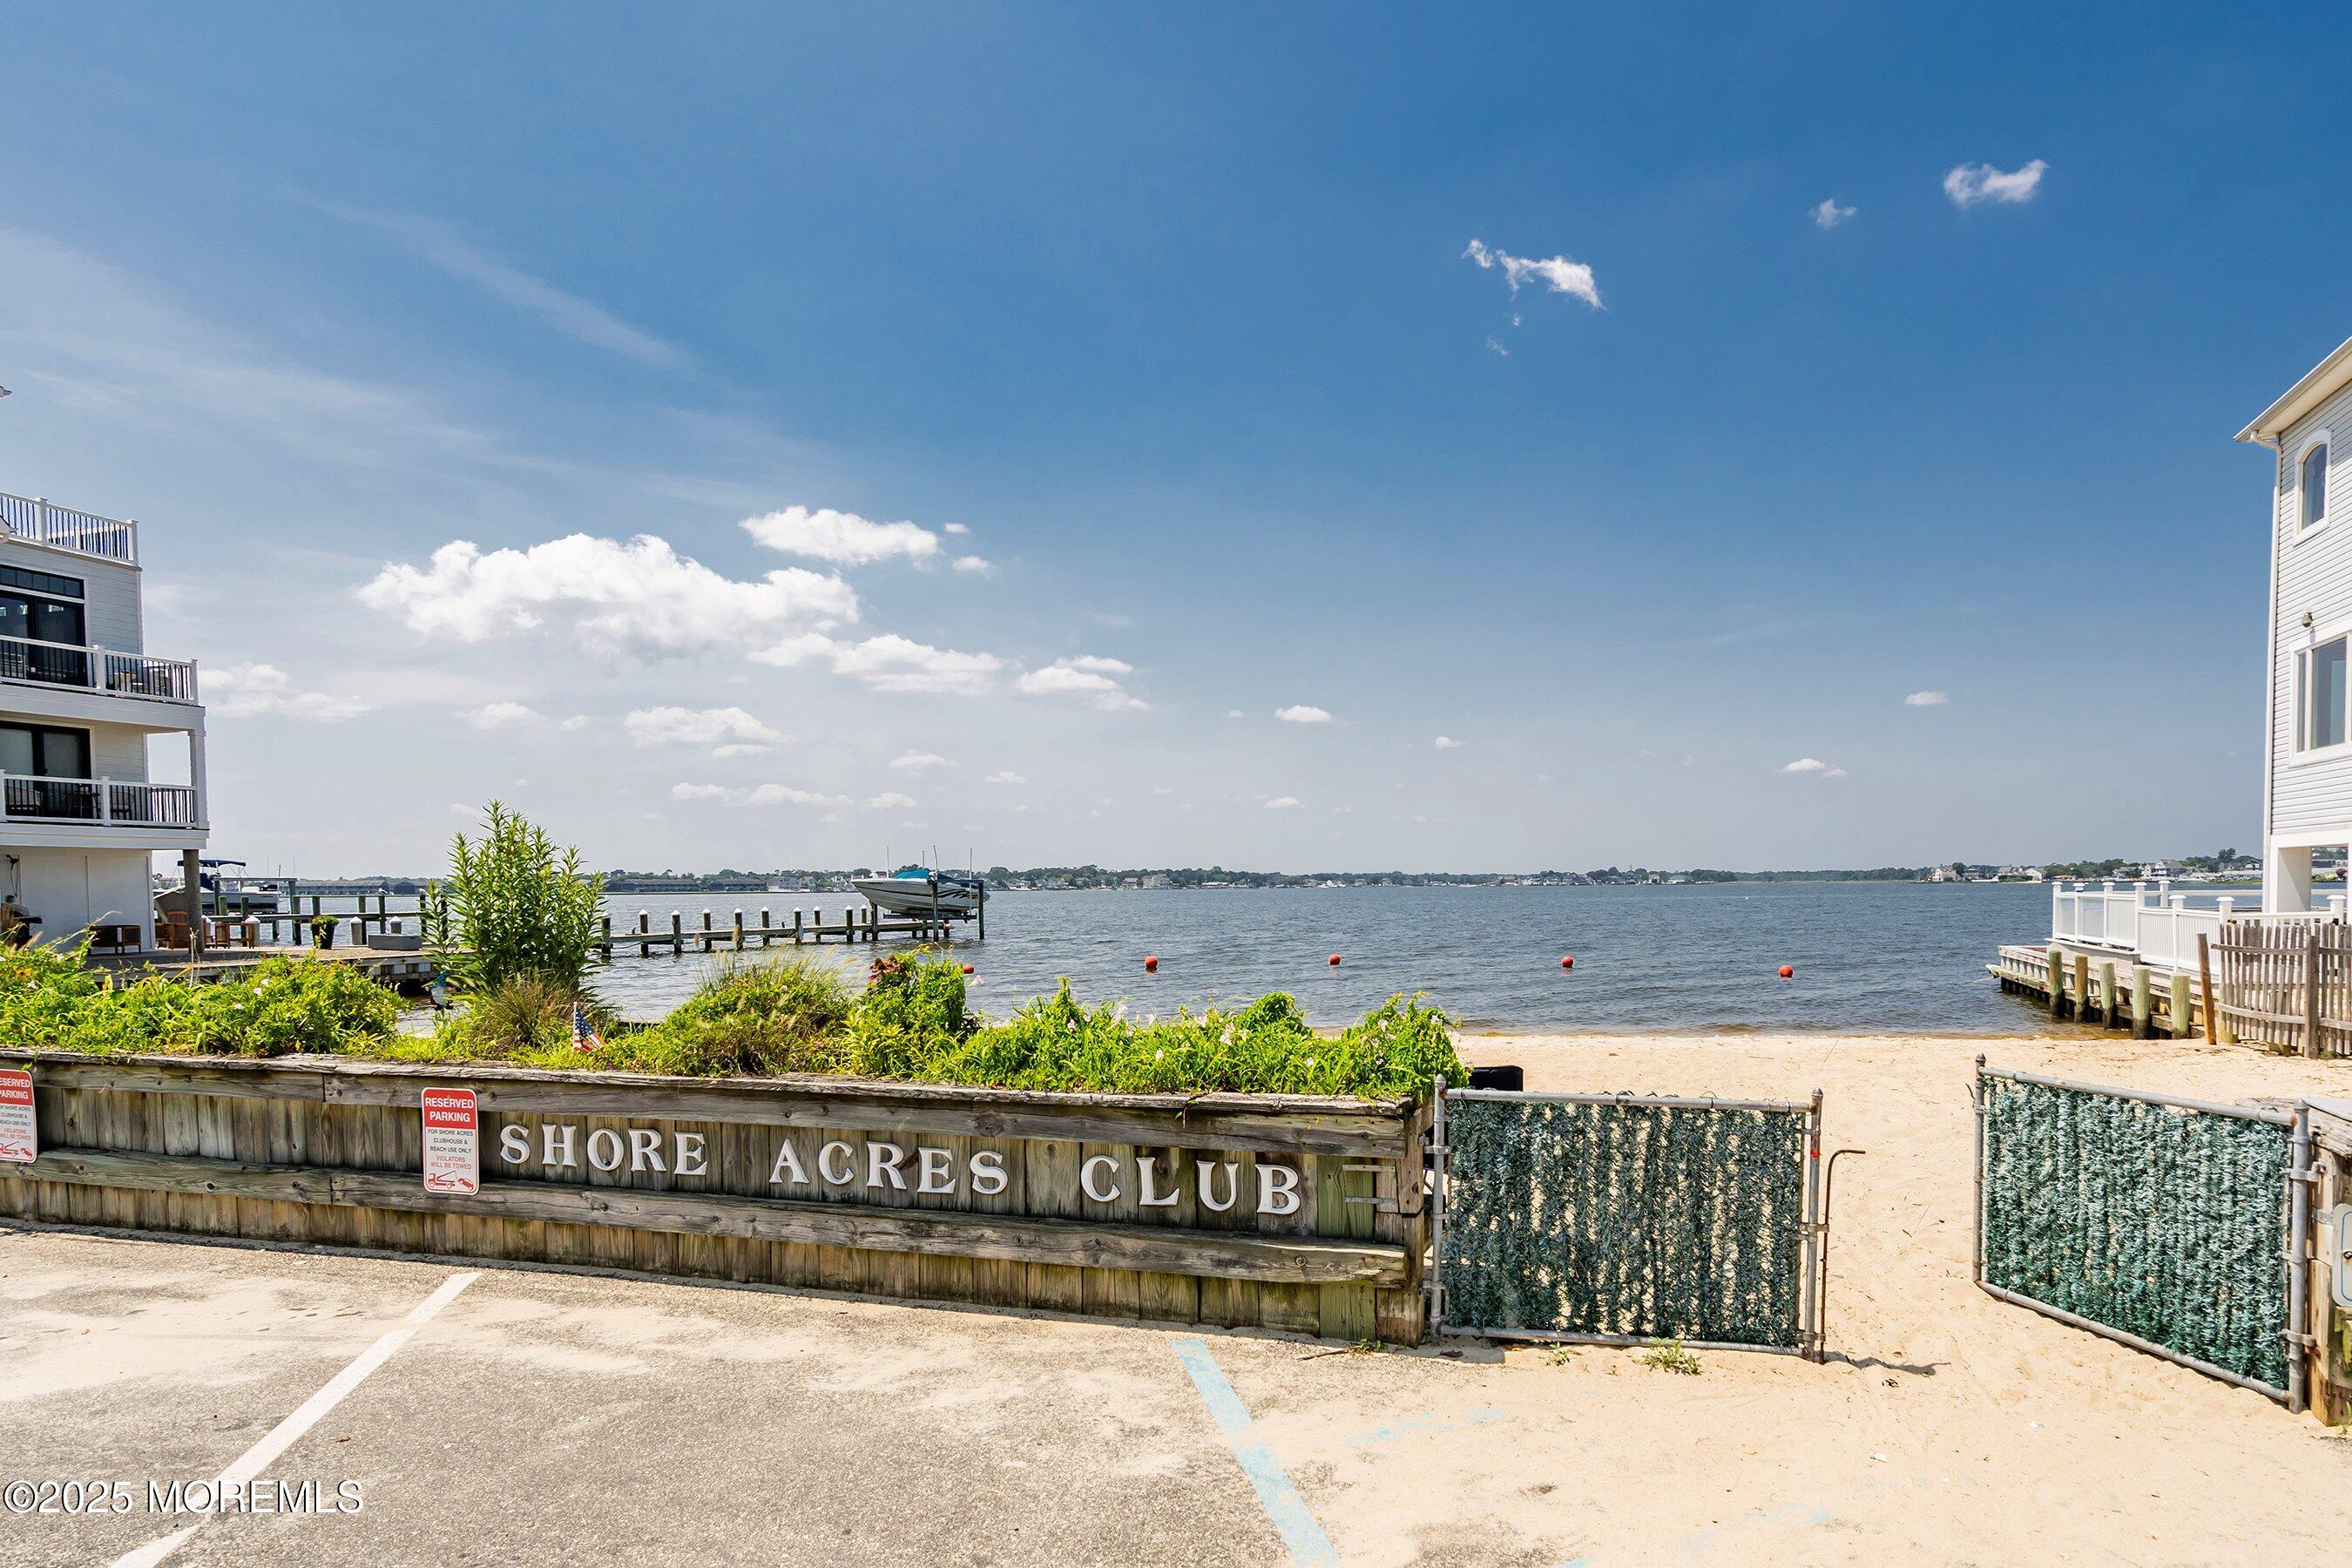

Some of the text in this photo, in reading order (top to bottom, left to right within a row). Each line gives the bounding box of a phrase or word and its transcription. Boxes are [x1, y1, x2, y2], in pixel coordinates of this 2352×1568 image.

[0, 1078, 30, 1087] ESERVED
[425, 1098, 474, 1108] RESERVED
[429, 1112, 470, 1122] PARKING
[500, 1123, 1301, 1215] SHORE ACRES CLUB
